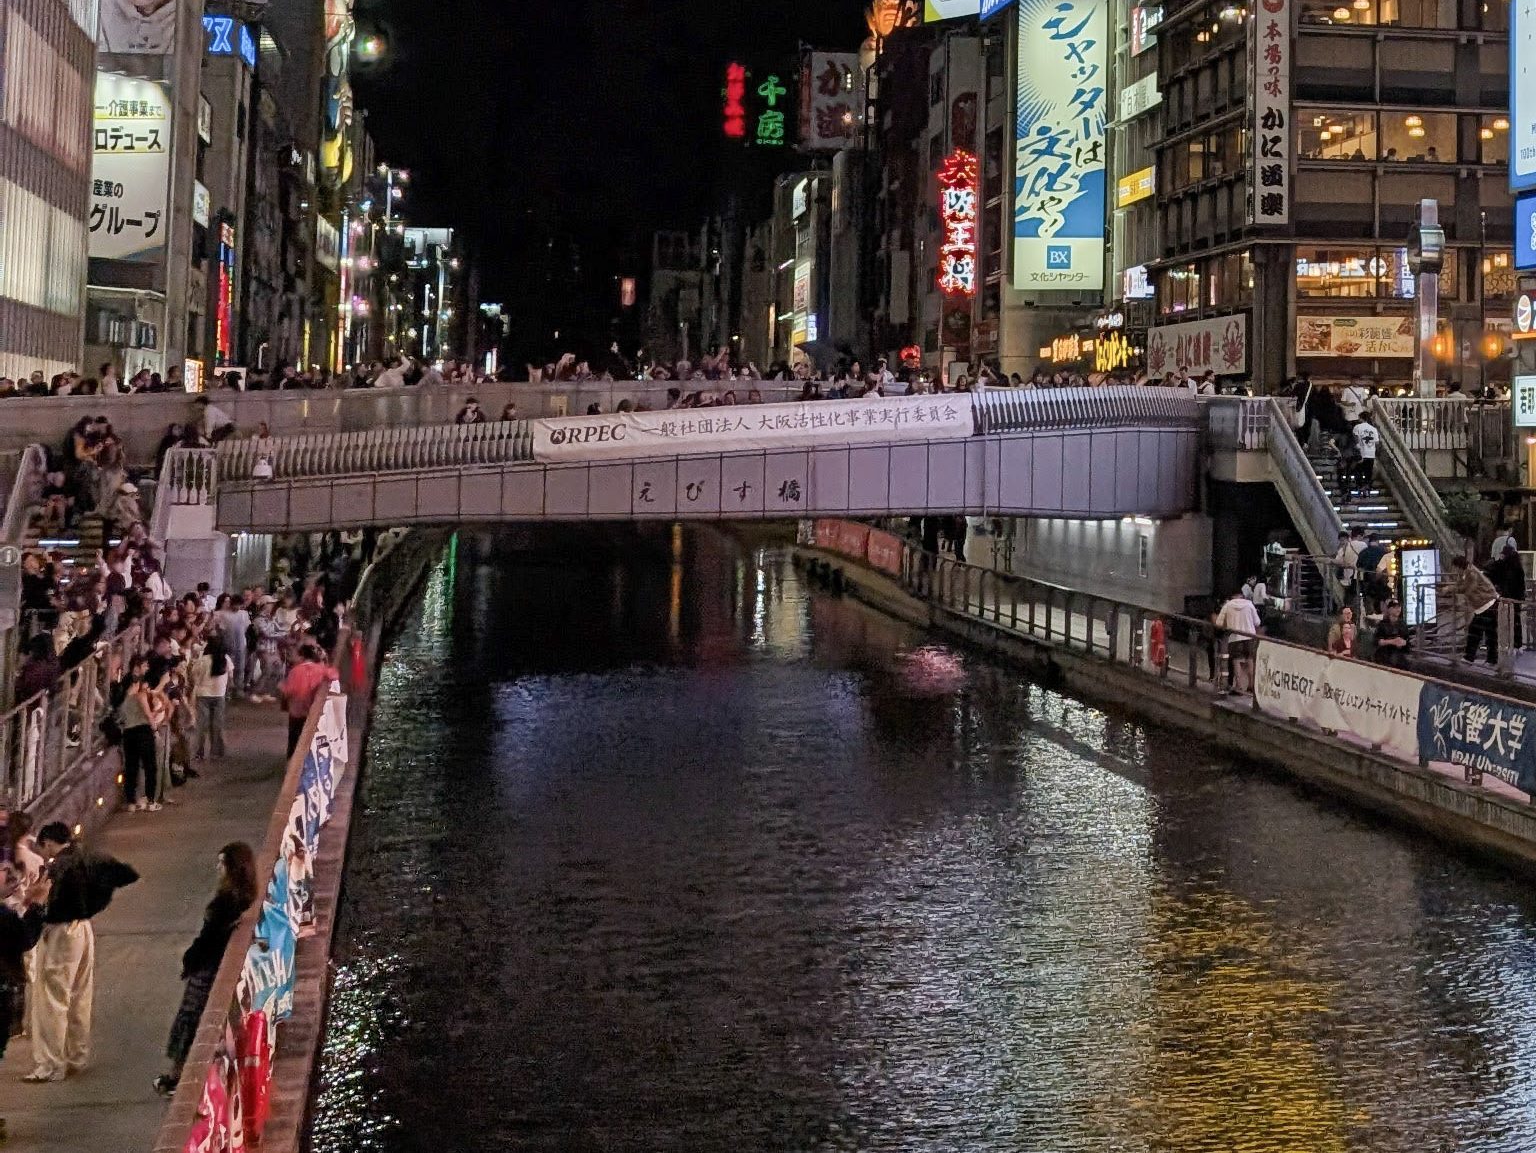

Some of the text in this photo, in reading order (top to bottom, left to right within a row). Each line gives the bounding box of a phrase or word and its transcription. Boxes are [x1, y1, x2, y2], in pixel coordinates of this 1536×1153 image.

[1263, 19, 1283, 97] 本場の味
[89, 202, 161, 239] グループ
[1050, 250, 1068, 264] BX
[641, 414, 751, 439] 一般社団法人
[758, 404, 959, 432] 大阪活性化事業実行委員会
[638, 479, 801, 503] えびす橋
